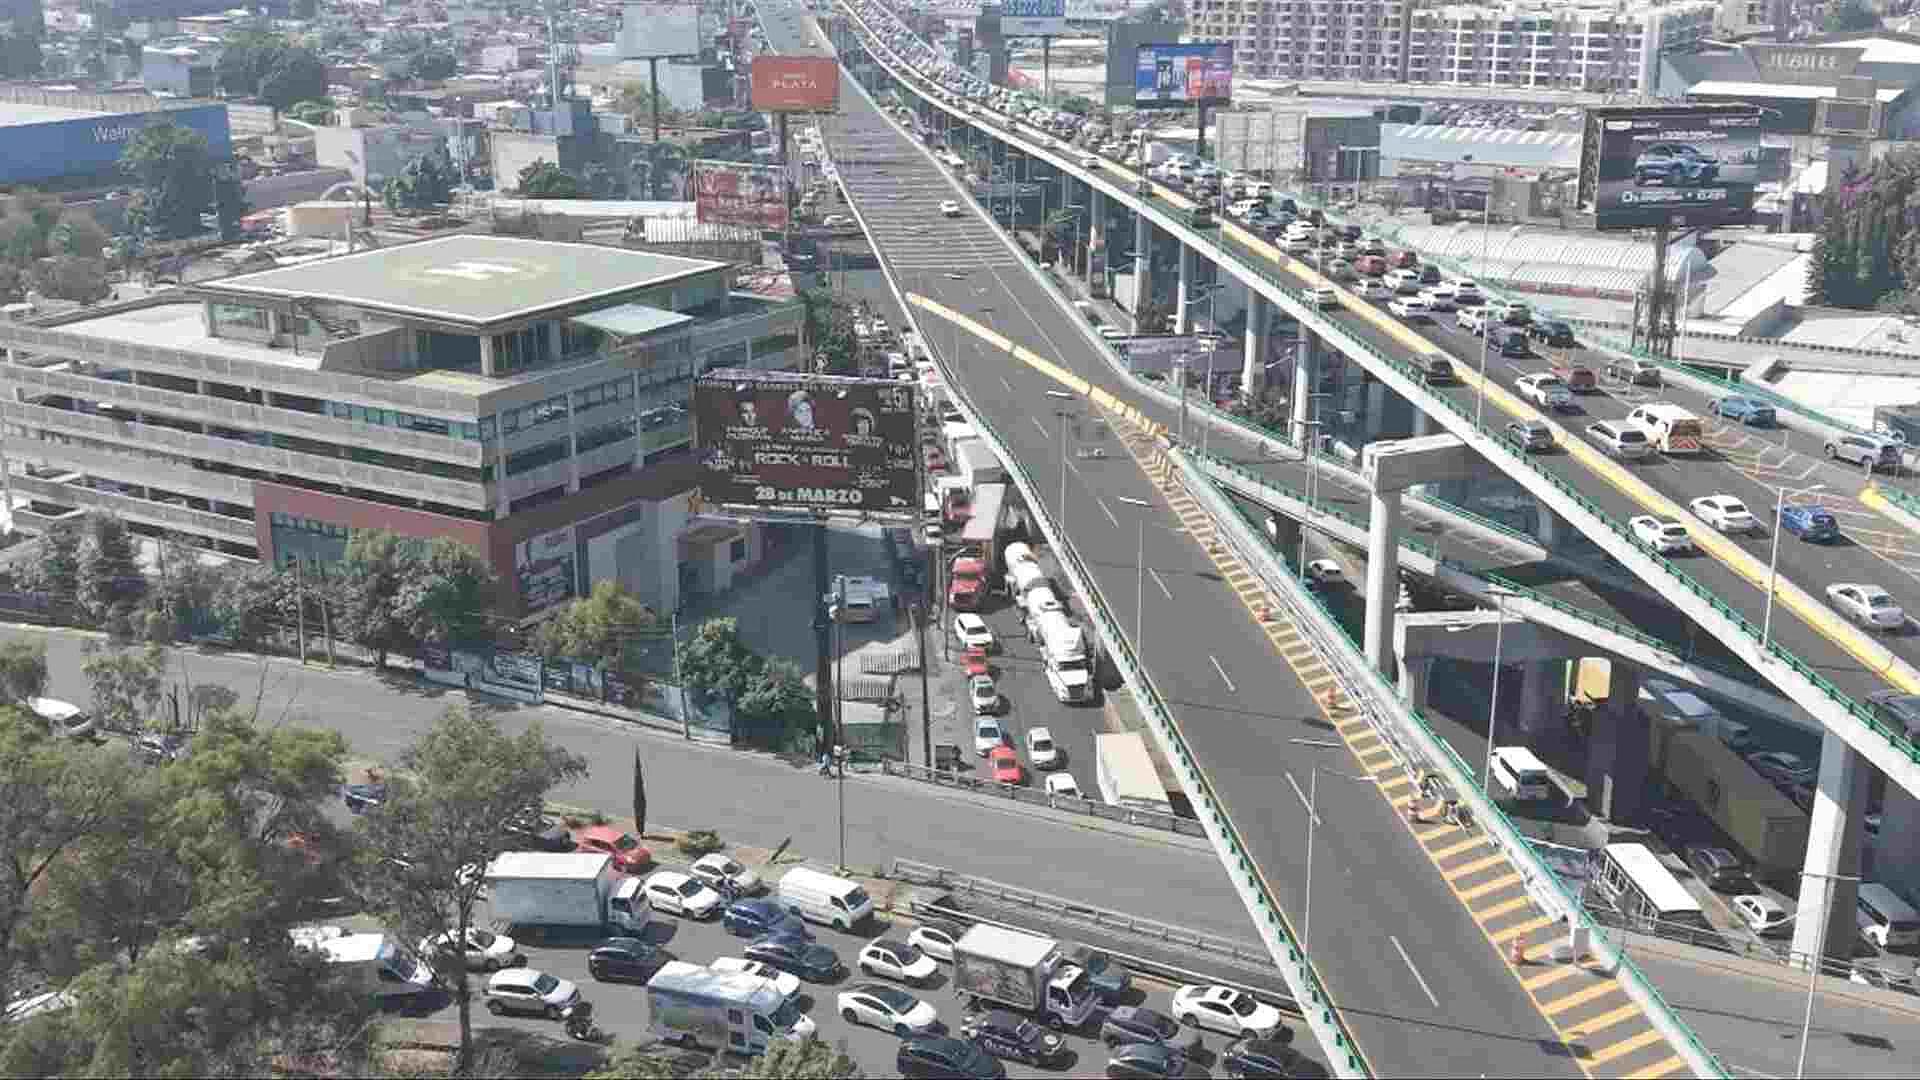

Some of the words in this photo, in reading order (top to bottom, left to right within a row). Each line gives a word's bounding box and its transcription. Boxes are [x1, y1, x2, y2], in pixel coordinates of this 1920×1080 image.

[754, 452, 800, 466] ROCK
[811, 454, 849, 468] ROLL
[755, 486, 776, 500] 28
[797, 487, 863, 504] MARZO
